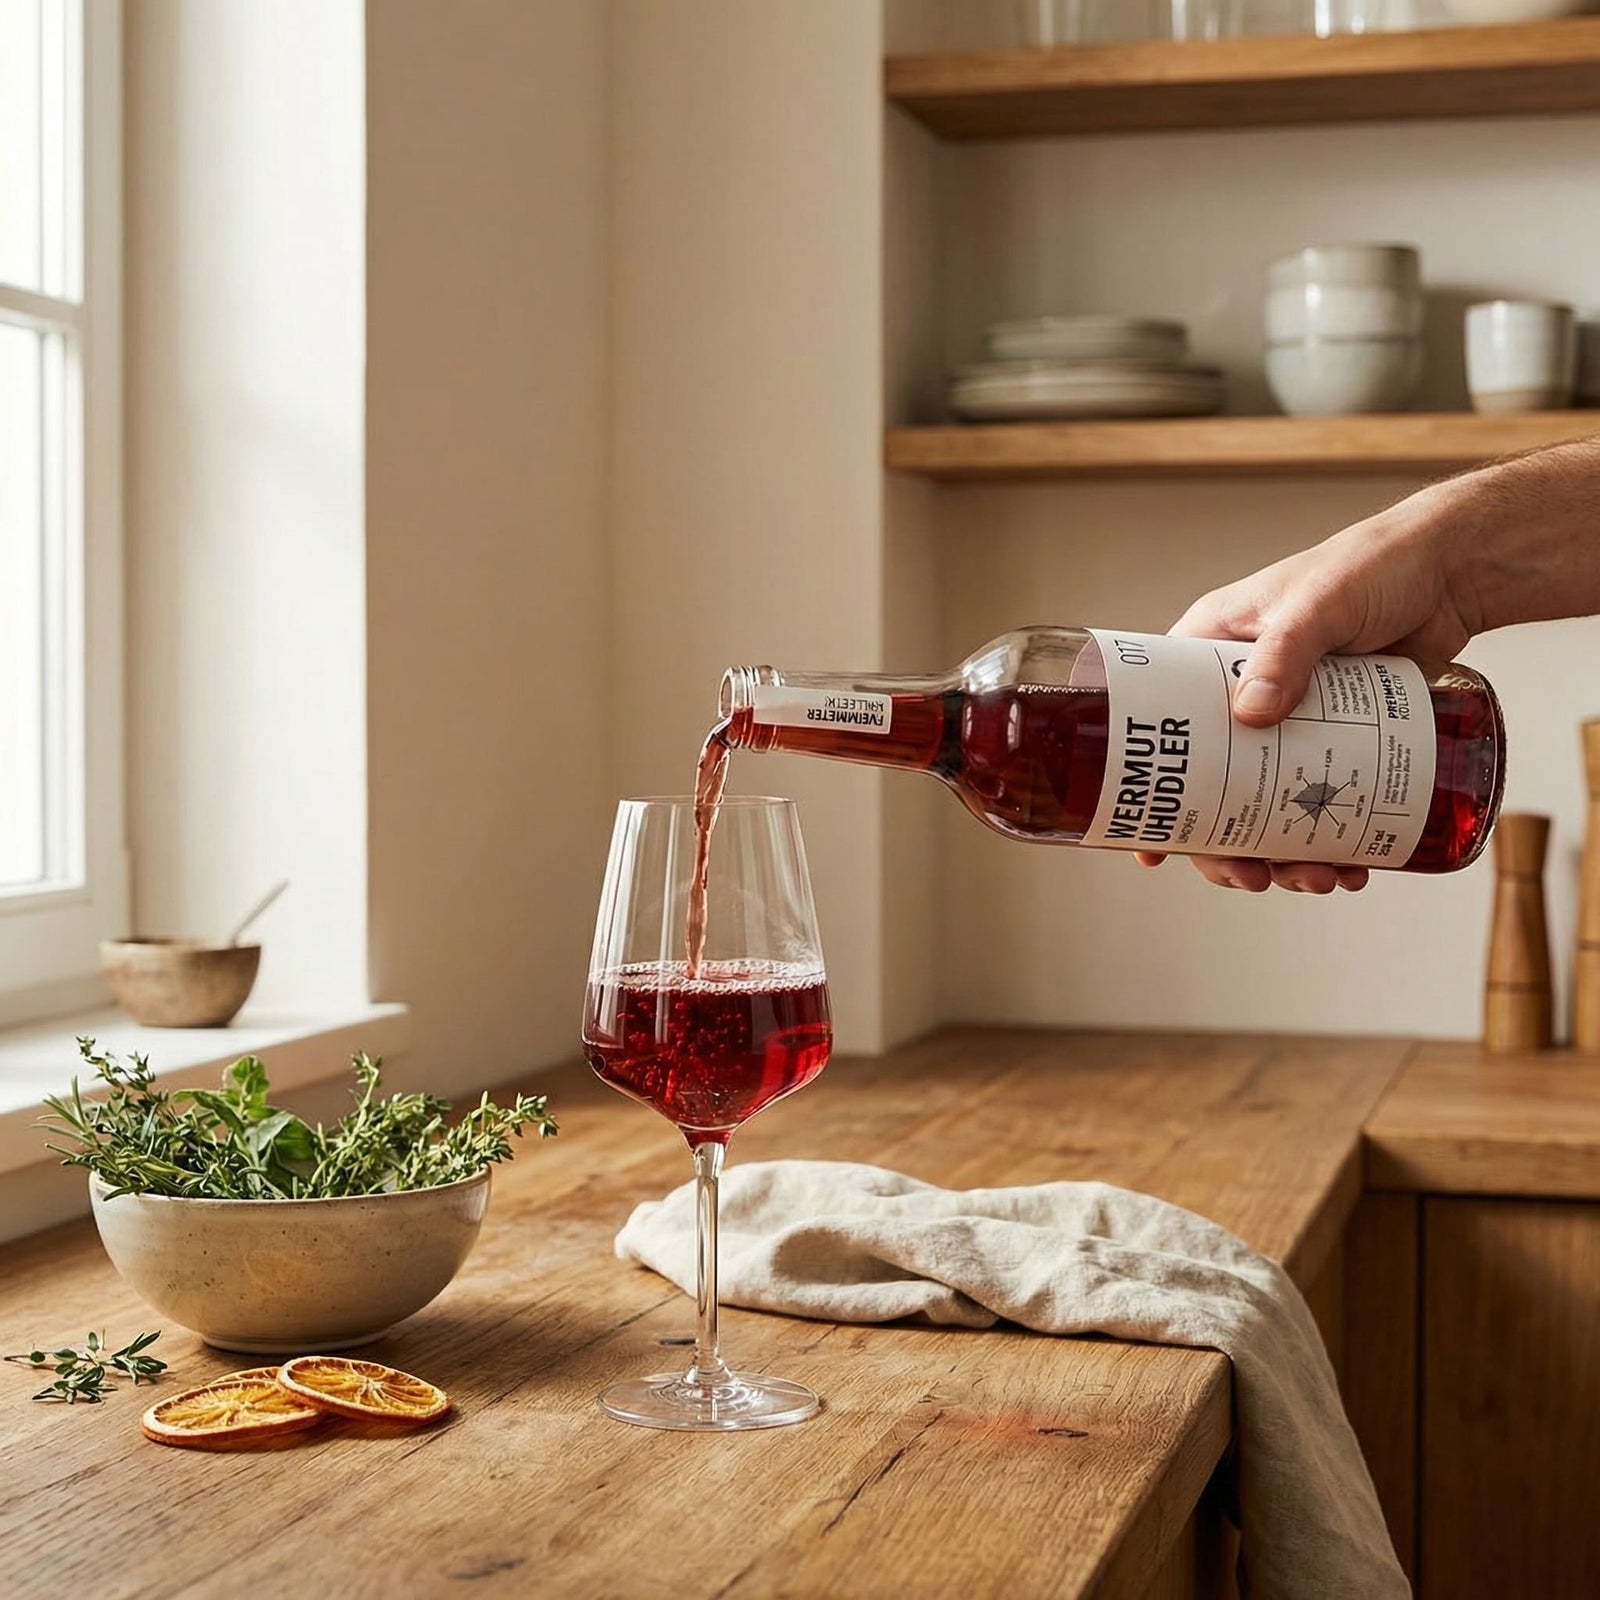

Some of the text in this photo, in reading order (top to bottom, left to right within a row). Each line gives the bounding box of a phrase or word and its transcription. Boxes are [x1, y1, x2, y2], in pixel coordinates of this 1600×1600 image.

[1114, 639, 1150, 666] 017
[1104, 716, 1157, 839] WERMUT
[1139, 717, 1190, 843] UHUDLER
